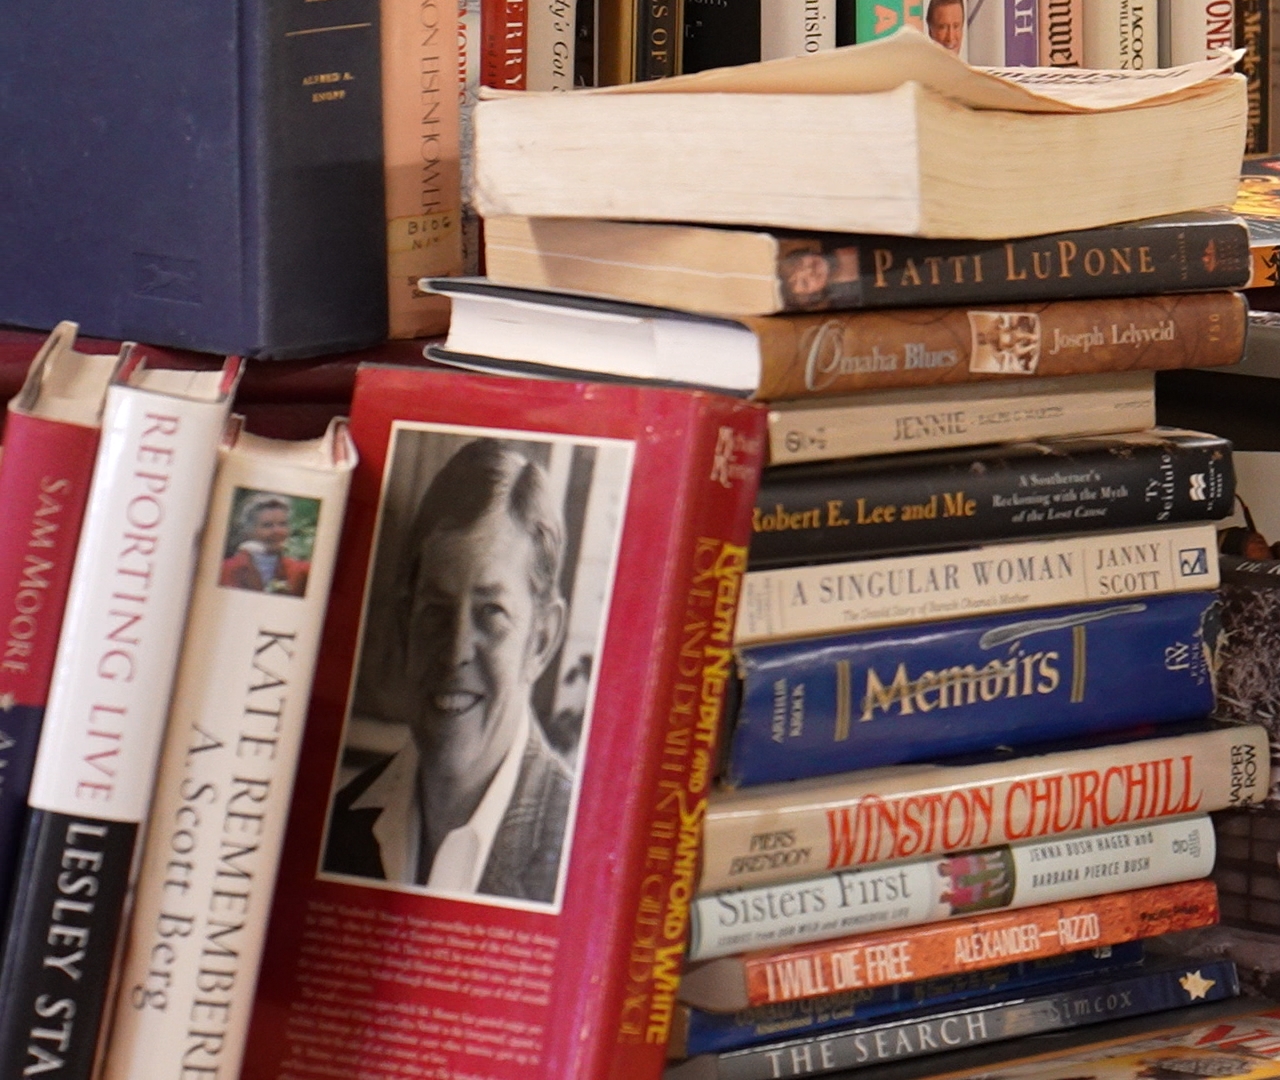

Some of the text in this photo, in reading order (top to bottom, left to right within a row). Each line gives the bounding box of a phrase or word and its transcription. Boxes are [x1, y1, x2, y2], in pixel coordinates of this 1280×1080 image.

[650, 26, 667, 63] OF
[1206, 3, 1232, 50] ONE
[551, 49, 569, 79] Got
[805, 319, 957, 391] Omaha Blues
[1049, 325, 1105, 354] Joseph
[893, 411, 967, 442] JENNIE
[1053, 491, 1077, 505] with
[1079, 488, 1098, 502] the
[1100, 485, 1129, 502] Myth
[1144, 478, 1160, 502] Ty
[1156, 453, 1173, 522] Seidule
[827, 500, 848, 527] E.
[856, 498, 896, 525] Lee
[901, 494, 939, 521] and
[943, 491, 977, 518] Me
[1096, 542, 1162, 571] JANNY
[3, 477, 71, 674] SAM MOORE
[790, 551, 1073, 607] A SINGULAR WOMAN
[1098, 569, 1160, 596] SCOTT
[75, 412, 181, 801] REPORTING LIVE
[862, 644, 1060, 720] Memoirs
[826, 754, 1204, 871] WINSTON CHURCHILL
[749, 828, 794, 851] PIERS
[1030, 831, 1155, 863] JENNA BUSH HAGER and
[131, 725, 225, 1013] A. Scott Berg
[728, 844, 812, 876] BRENDON
[1031, 858, 1151, 888] BARBARA PIERCE BUSH
[717, 868, 912, 928] Sisters First
[765, 1014, 990, 1078] THE SEARCH
